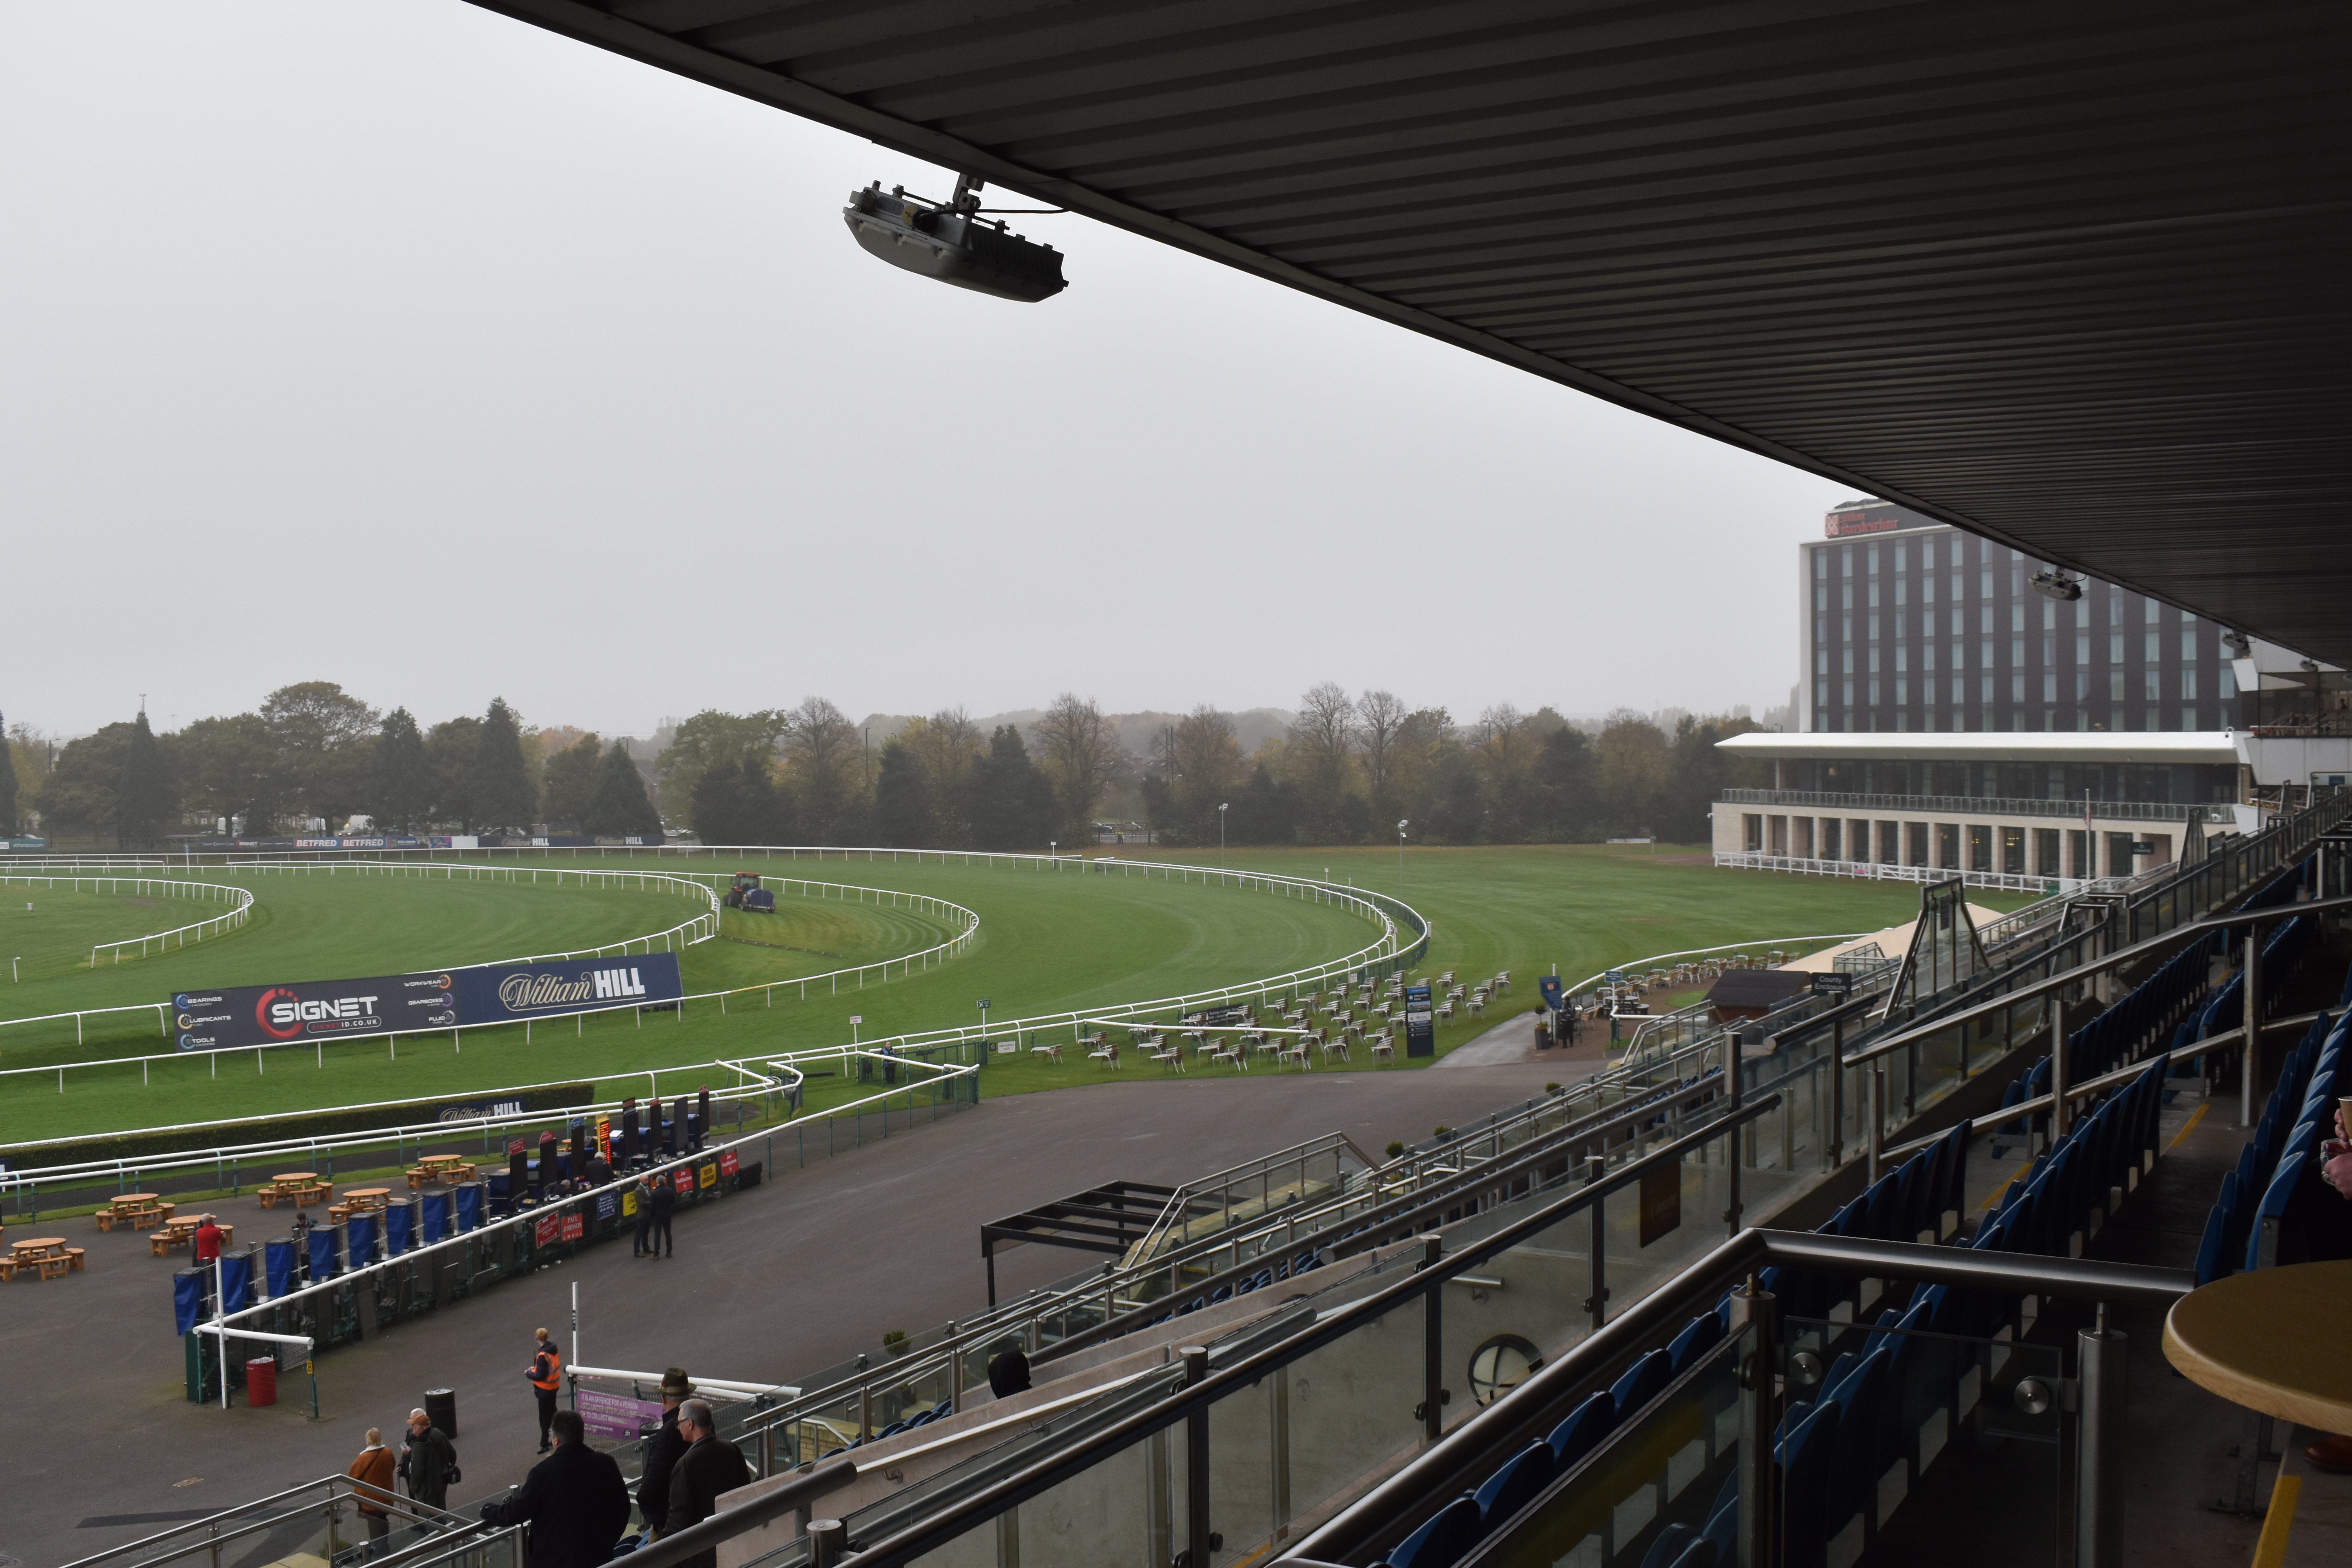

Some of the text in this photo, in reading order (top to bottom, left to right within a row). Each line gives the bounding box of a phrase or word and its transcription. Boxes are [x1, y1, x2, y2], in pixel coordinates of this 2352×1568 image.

[1879, 518, 1897, 530] Inn
[501, 837, 549, 847] William HILL
[594, 836, 643, 846] William HILL
[499, 967, 646, 1008] William HILL
[272, 996, 378, 1023] SIGNET
[312, 1019, 377, 1030] SIGNETID.CO.UK
[439, 1102, 523, 1122] William HILL
[702, 1175, 715, 1185] JOHNSON
[563, 1222, 582, 1233] JOHNSON
[590, 1404, 604, 1412] UNDER
[595, 1396, 612, 1406] OFFENCE
[622, 1401, 638, 1410] PERSON
[592, 1413, 608, 1421] COLLECT
[608, 1415, 627, 1425] WINNINGS
